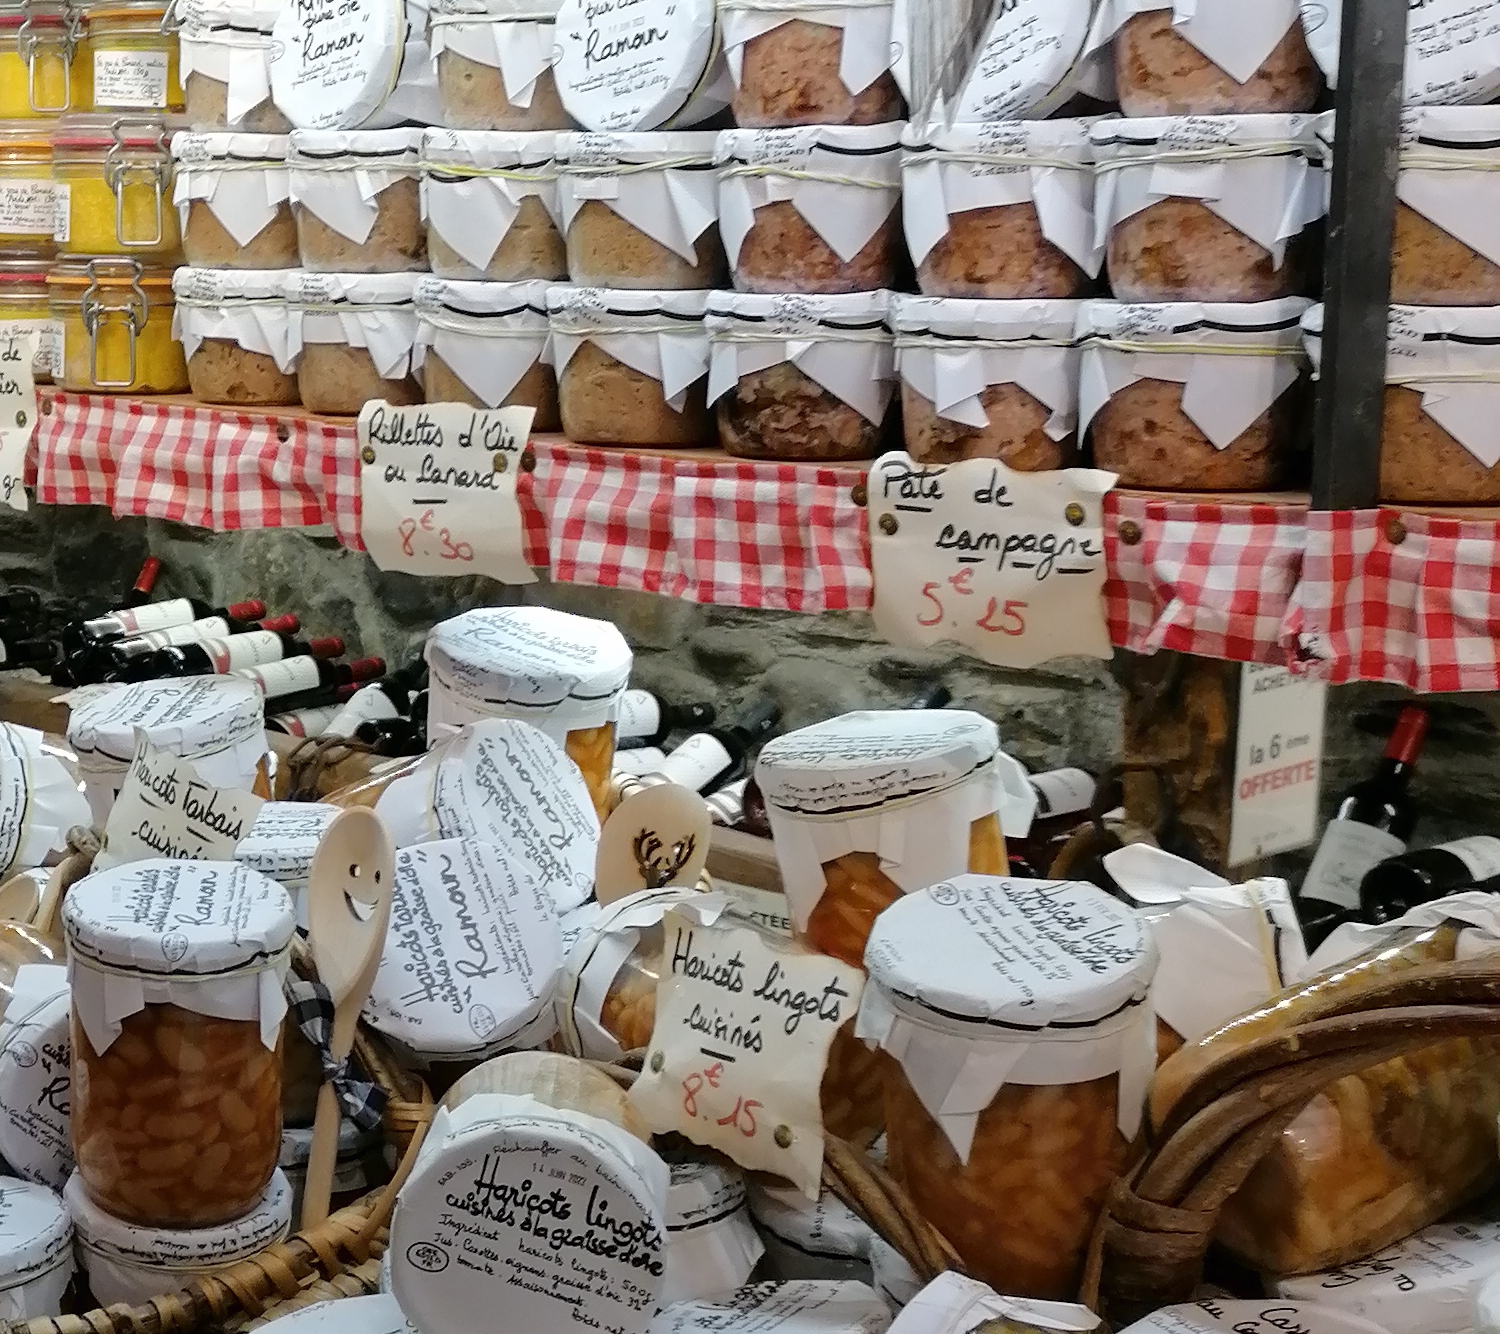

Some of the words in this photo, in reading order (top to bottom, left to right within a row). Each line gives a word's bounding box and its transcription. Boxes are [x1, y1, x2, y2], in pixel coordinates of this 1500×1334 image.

[2, 339, 22, 362] de
[369, 407, 444, 447] Rillettes
[415, 454, 500, 490] Canard
[974, 468, 1013, 507] de
[935, 524, 1102, 580] campagne
[1250, 743, 1263, 765] la
[1269, 733, 1282, 759] 6
[132, 740, 181, 806] Haricots
[181, 780, 243, 841] Tarbais
[1239, 759, 1316, 801] OFFERTE
[131, 819, 209, 861] cuisiné
[672, 927, 746, 994] Haricots
[753, 961, 849, 1035] lingots
[446, 1191, 516, 1228] cuisinés
[473, 1152, 572, 1220] Haricots
[586, 1184, 663, 1252] lingots
